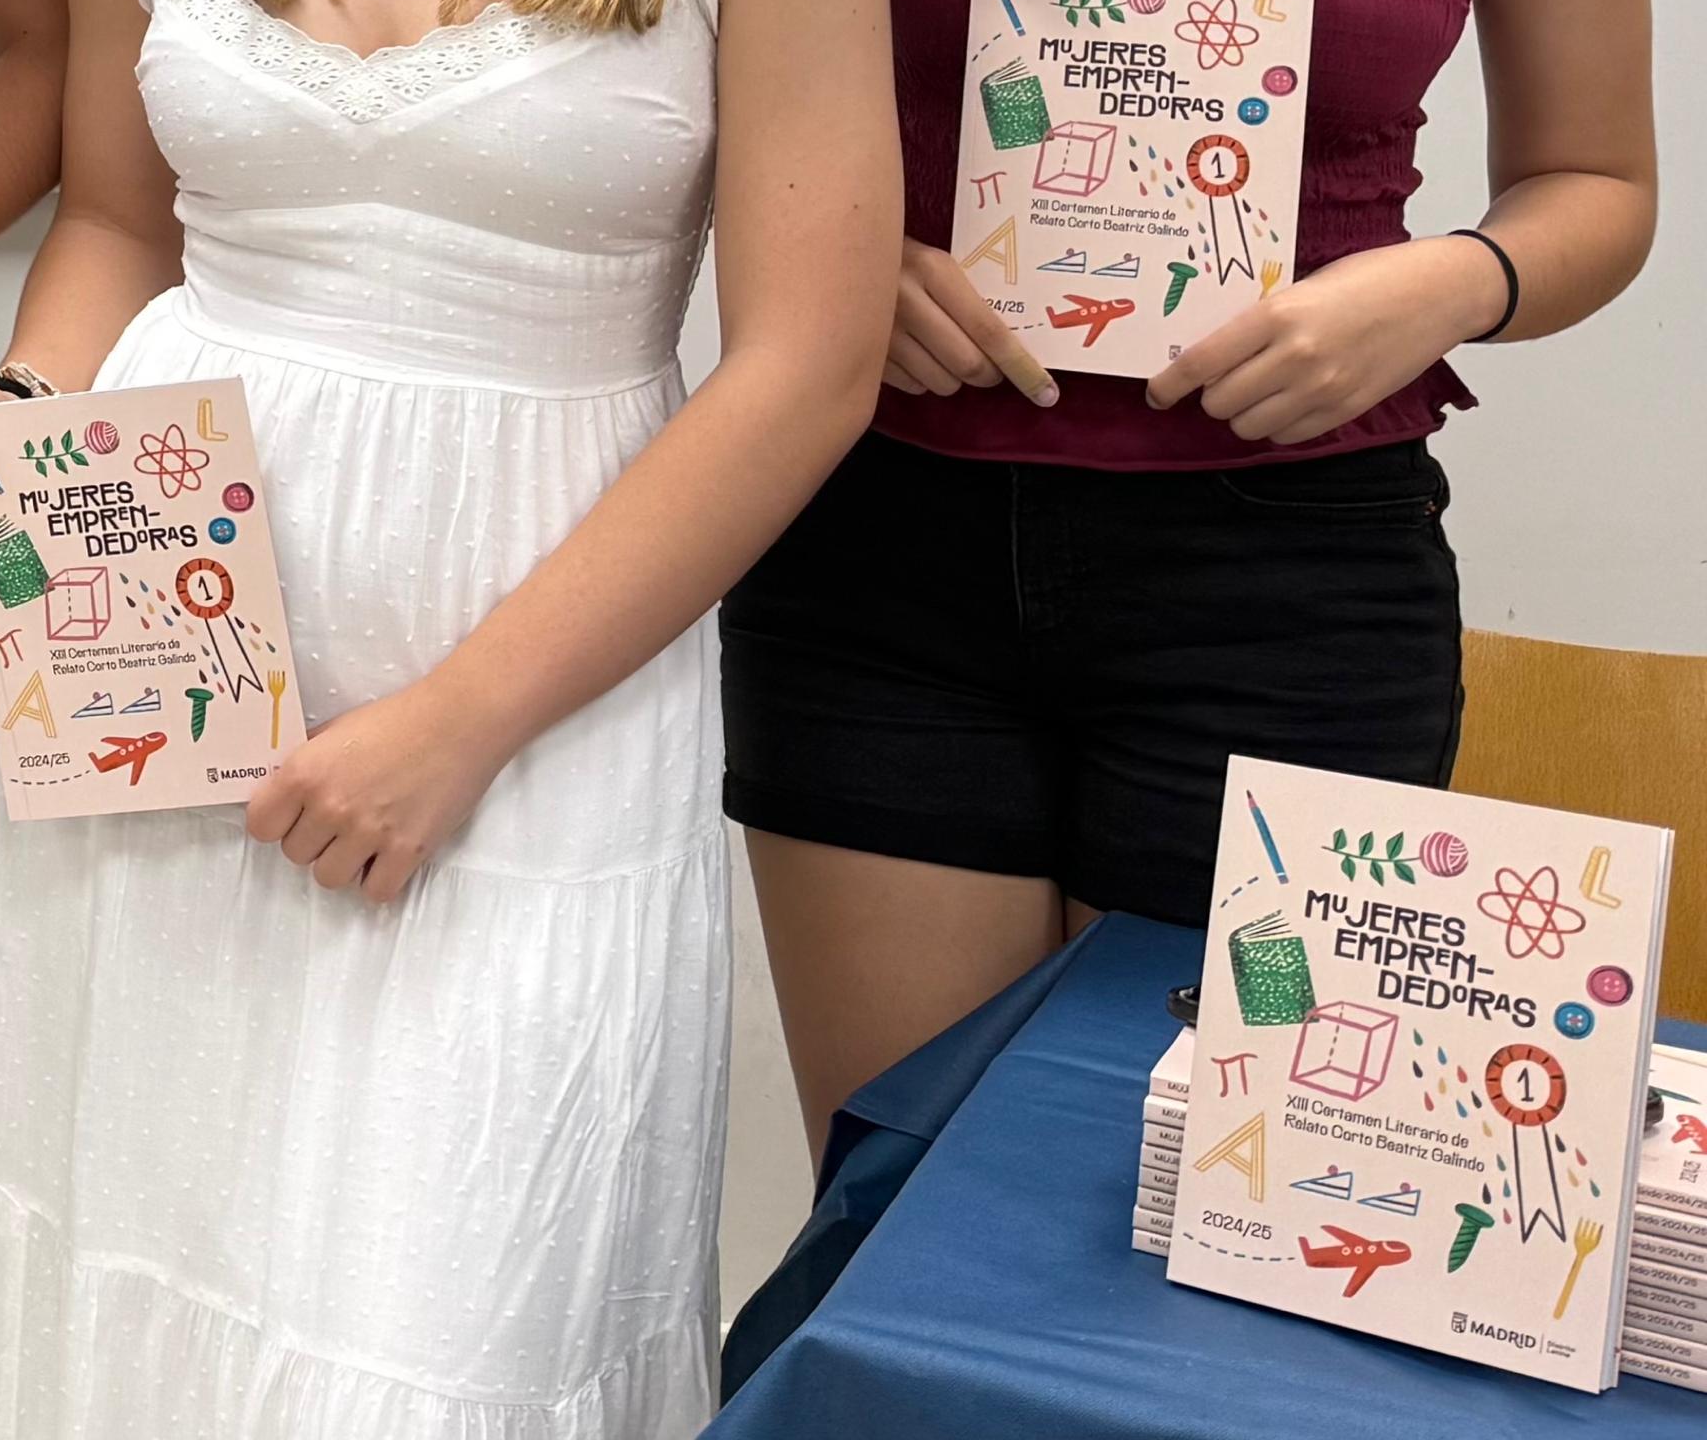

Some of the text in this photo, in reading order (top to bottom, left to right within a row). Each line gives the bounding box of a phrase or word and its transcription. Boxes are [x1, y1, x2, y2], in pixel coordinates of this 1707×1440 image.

[1038, 37, 1167, 68] MUJERES
[1063, 64, 1191, 94] EMPREN-
[1098, 91, 1224, 123] DEDORAS
[1210, 151, 1225, 179] 1
[18, 480, 135, 515] MUJERES
[46, 503, 161, 537] EMPREN-
[84, 524, 198, 558] DEDORAS
[197, 575, 214, 602] 1
[67, 646, 120, 659] Certamen
[120, 640, 167, 655] Literario
[167, 638, 181, 650] de
[18, 751, 71, 768] 2024/25
[219, 768, 267, 782] MADRID
[1303, 888, 1466, 947] MUJERES
[1333, 927, 1495, 984] EMPREN-
[1376, 968, 1537, 1028] DEDORAS
[1516, 1066, 1534, 1102] 1
[1285, 1093, 1469, 1149] XIII Certamen Literario de
[1283, 1112, 1485, 1173] Relato Corto Beatriz Galindo
[1201, 1209, 1272, 1240] 2024/25
[1469, 1320, 1536, 1349] MADRID
